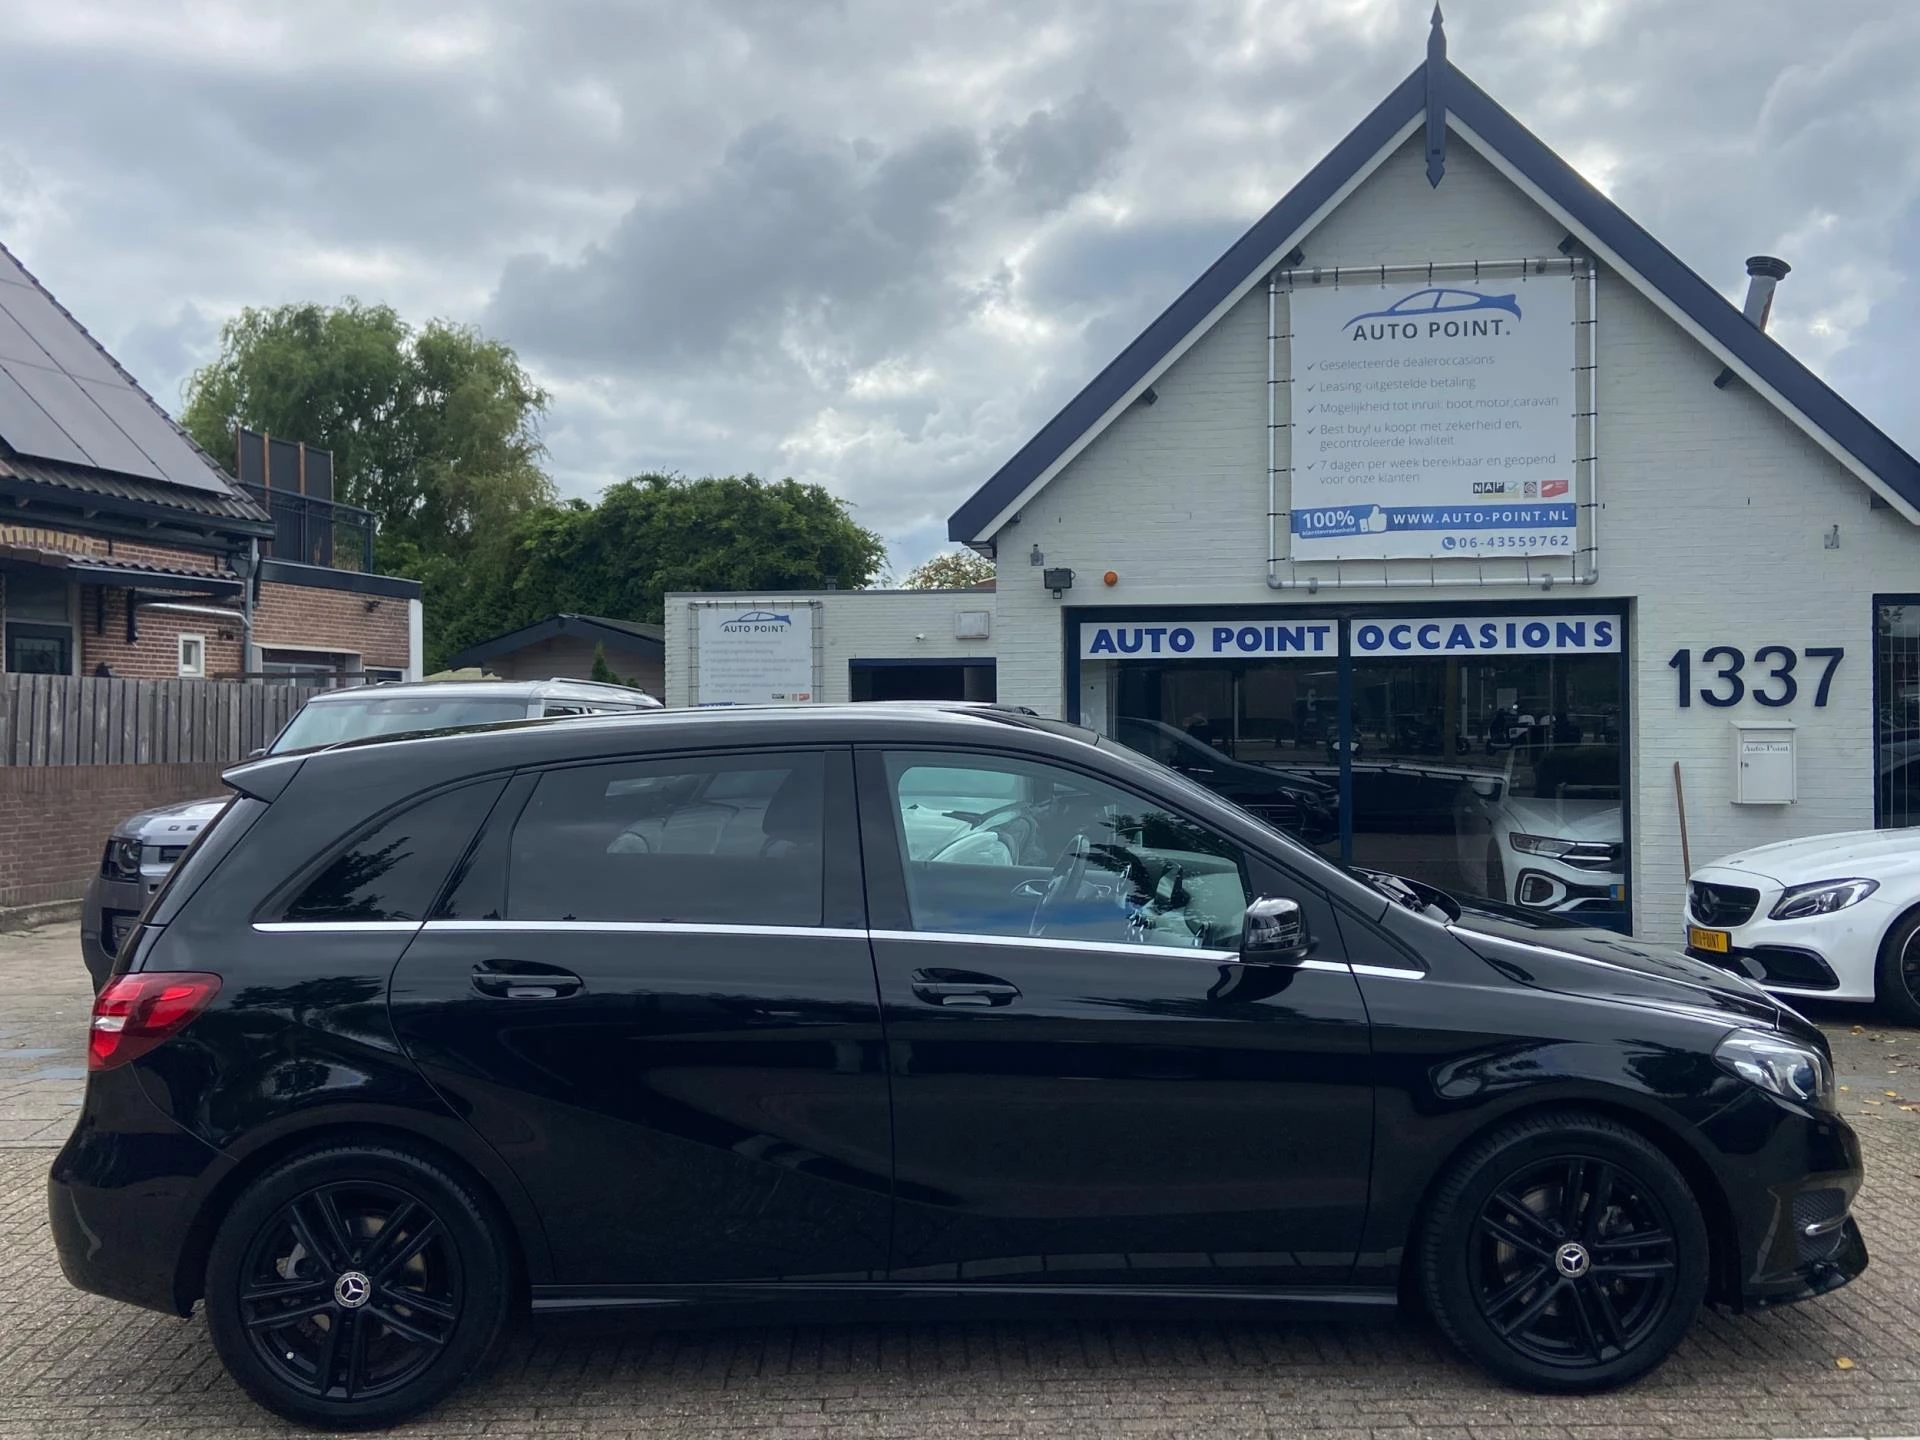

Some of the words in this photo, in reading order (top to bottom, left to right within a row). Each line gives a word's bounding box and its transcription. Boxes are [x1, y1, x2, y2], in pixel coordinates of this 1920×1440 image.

[1353, 323, 1418, 341] AUTO
[1320, 358, 1400, 371] Geselecteerde
[1403, 354, 1495, 368] dealeroccasions
[1320, 381, 1361, 393] Leasing
[1366, 378, 1427, 392] uitgestelde
[1430, 376, 1476, 390] betaling
[1320, 401, 1389, 415] Mogelijkheid
[1393, 401, 1408, 411] tot
[1320, 423, 1344, 434] Best
[1347, 423, 1371, 436] buy!
[1374, 425, 1381, 433] u
[1385, 421, 1416, 433] koopt
[1420, 421, 1441, 431] met
[1446, 418, 1501, 431] zekerheid
[1320, 437, 1405, 451] gecontroleerde
[1409, 434, 1454, 446] kwaliteit
[1320, 460, 1327, 470] 7
[1330, 459, 1364, 472] dagen
[1368, 460, 1388, 471] per
[1391, 457, 1419, 468] week
[1422, 455, 1482, 467] bereikbaar
[1487, 457, 1501, 465] en
[1504, 454, 1556, 467] geopend
[1320, 475, 1345, 484] voor
[1348, 473, 1375, 483] onze
[1379, 471, 1420, 483] klanten
[1473, 481, 1504, 494] NAP
[1302, 510, 1356, 529] 100%
[1393, 510, 1569, 525] WWW.AUTO-POINT.NL
[1459, 535, 1569, 548] 06-43559762
[1090, 628, 1195, 653] AUTO
[1212, 626, 1330, 652] POINT
[1357, 621, 1612, 650] OCCASIONS
[1669, 646, 1844, 707] 1337
